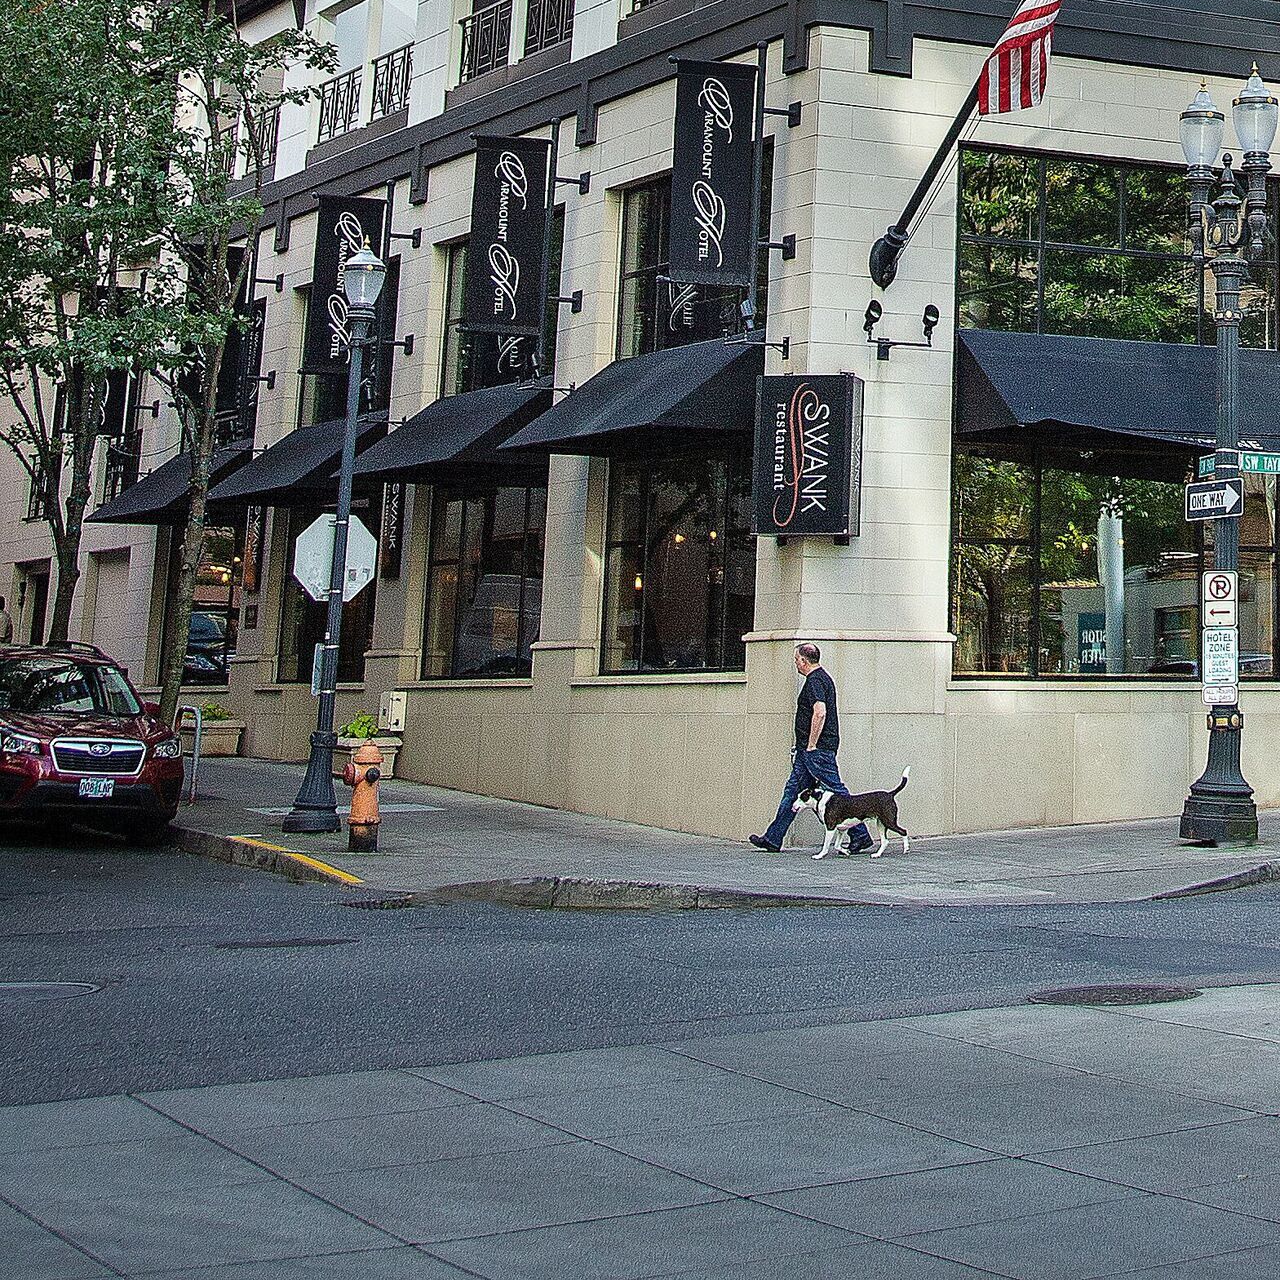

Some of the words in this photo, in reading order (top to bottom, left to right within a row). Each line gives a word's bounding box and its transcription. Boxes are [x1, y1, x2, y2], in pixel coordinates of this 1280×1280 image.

[698, 77, 734, 179] PARAMOUNT
[495, 151, 528, 242] PARAMOUNT
[692, 180, 726, 268] HOTEL
[488, 243, 520, 320] HOTEL
[773, 402, 789, 491] restaurant
[800, 397, 830, 513] SWANK
[1245, 455, 1258, 470] SW
[1192, 494, 1207, 509] ONE
[1209, 491, 1225, 506] WAY
[1207, 633, 1233, 642] HOTEL
[1209, 643, 1231, 652] ZONE
